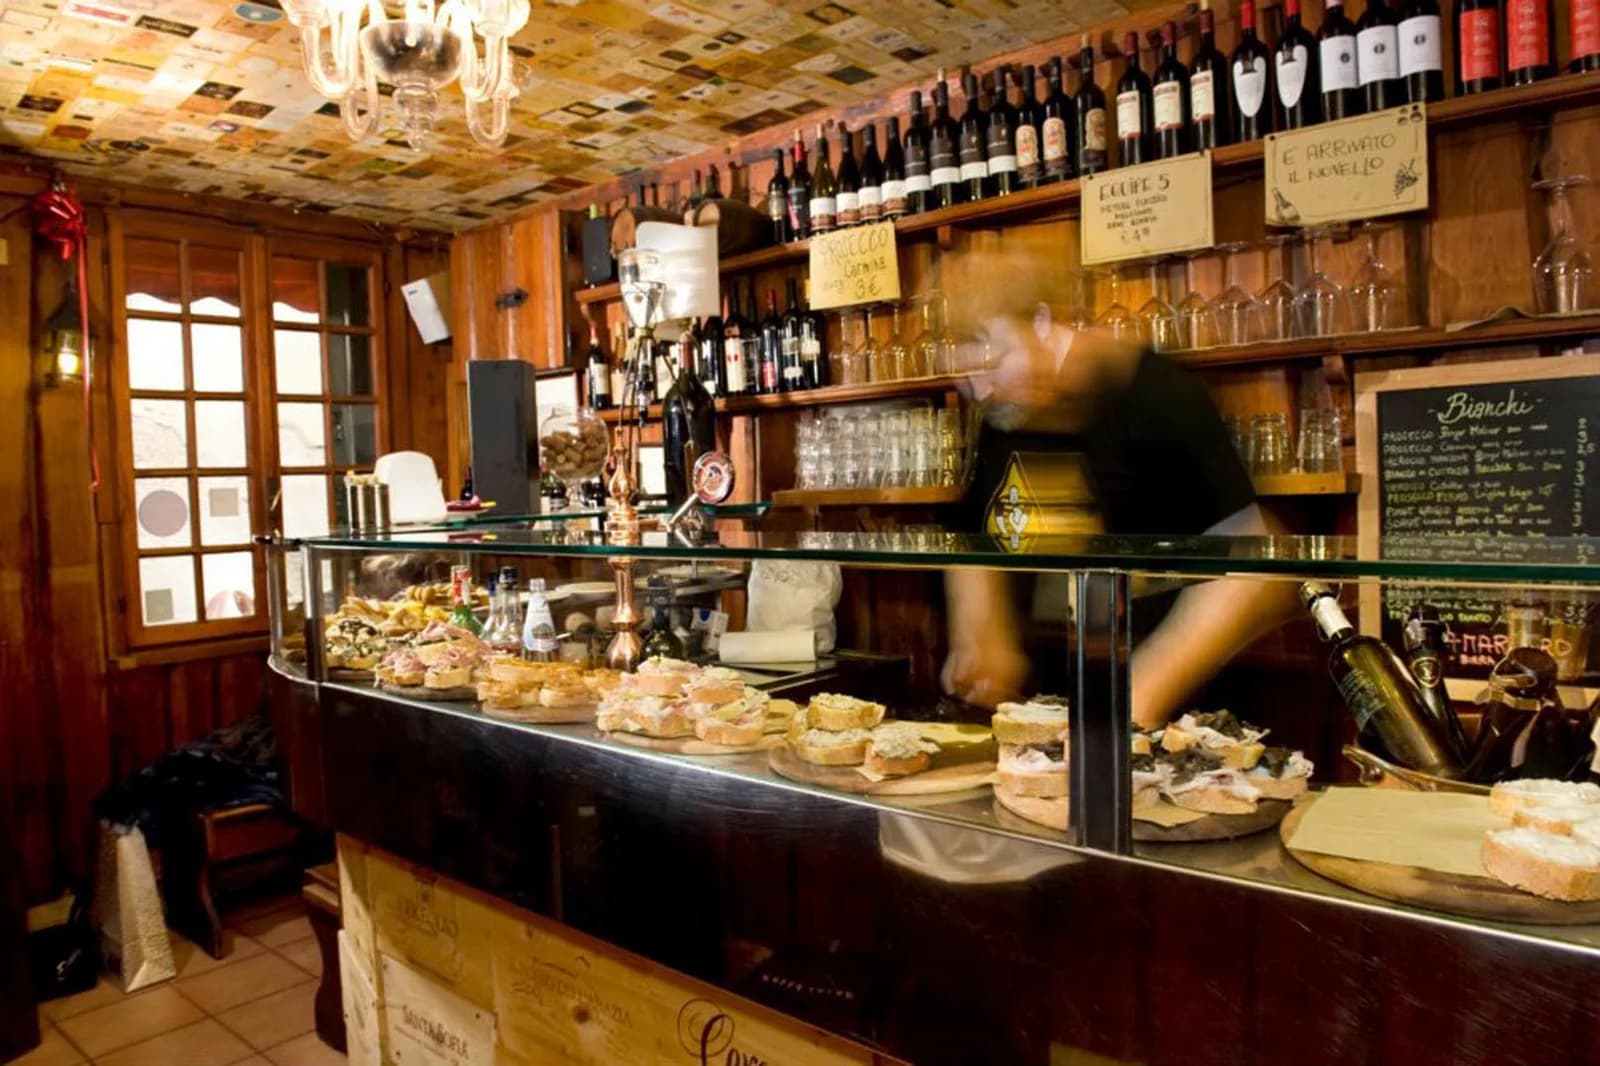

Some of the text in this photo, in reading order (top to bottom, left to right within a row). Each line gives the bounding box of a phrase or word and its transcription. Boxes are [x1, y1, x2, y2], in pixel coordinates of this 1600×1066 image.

[1308, 156, 1384, 181] NOVELLO
[1159, 173, 1170, 190] 5
[1437, 388, 1534, 424] Bianchi
